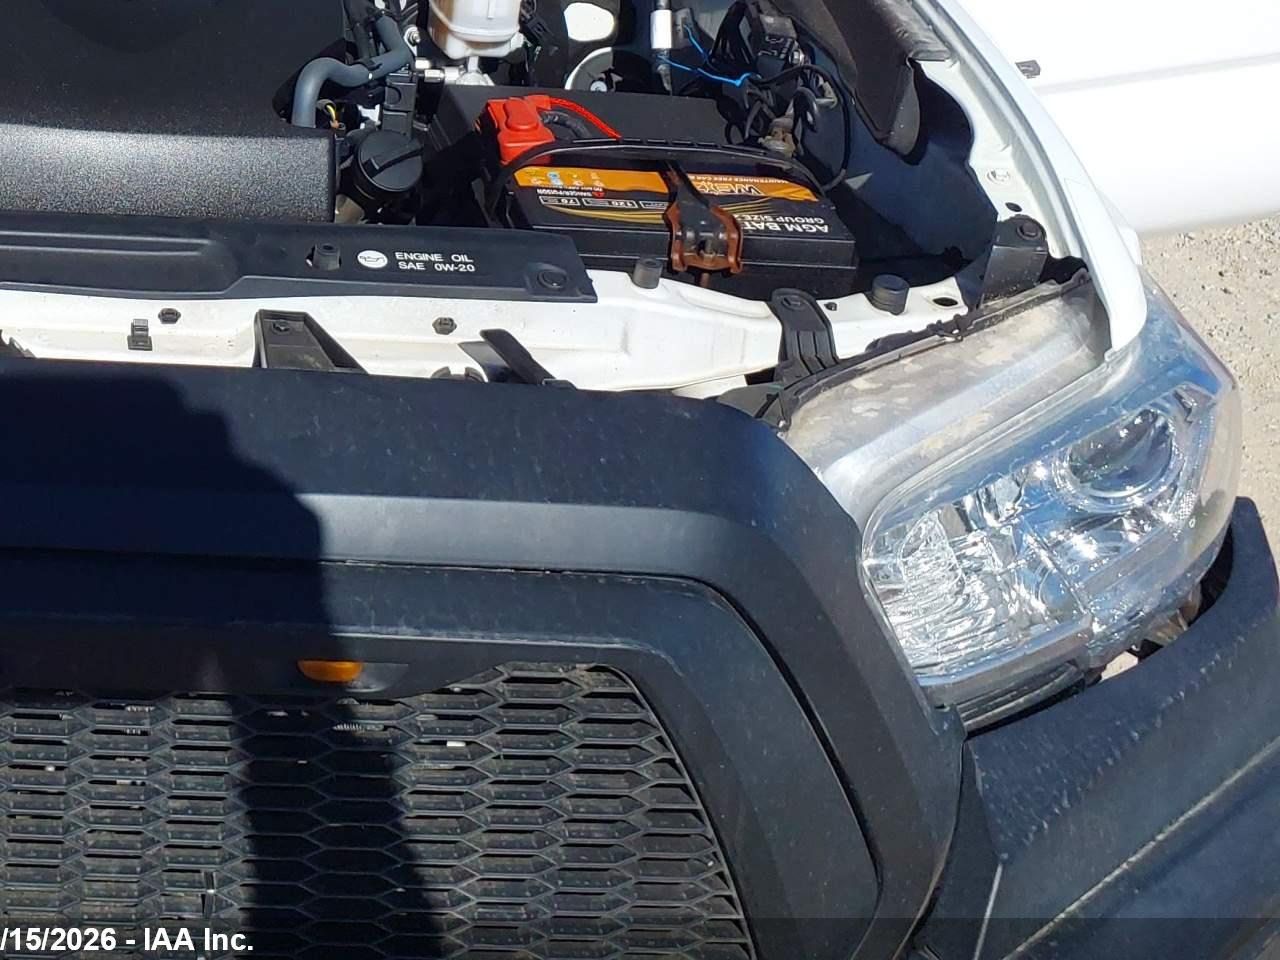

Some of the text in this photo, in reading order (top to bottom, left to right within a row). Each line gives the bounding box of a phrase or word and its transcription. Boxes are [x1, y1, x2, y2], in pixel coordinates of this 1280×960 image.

[742, 214, 774, 222] SIZE
[776, 216, 825, 225] GROUP
[741, 221, 829, 233] AGM BAT
[395, 252, 474, 262] ENGINE OIL
[398, 261, 475, 272] SAE 0W-20
